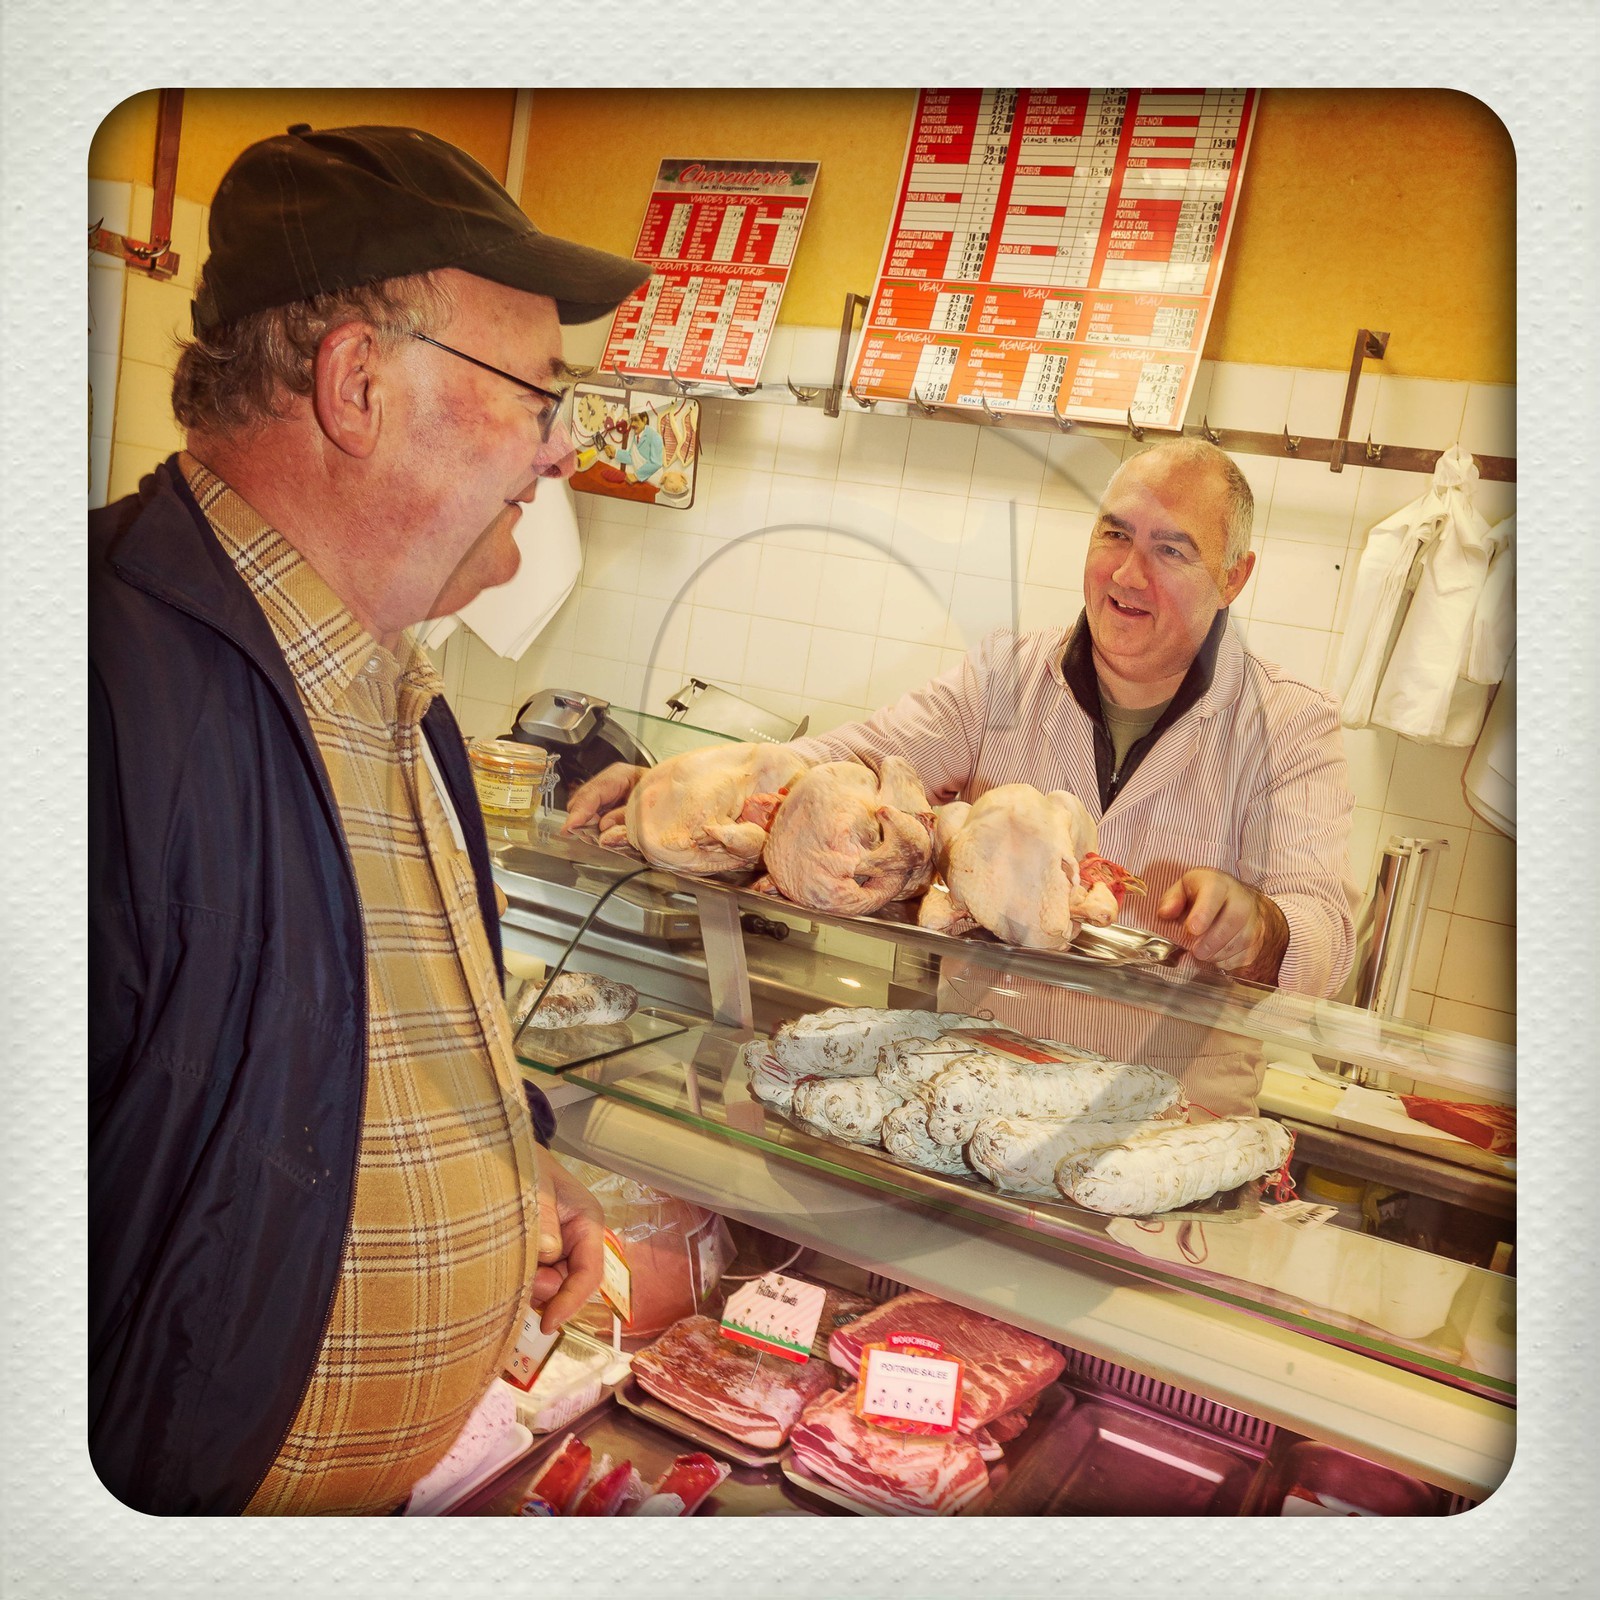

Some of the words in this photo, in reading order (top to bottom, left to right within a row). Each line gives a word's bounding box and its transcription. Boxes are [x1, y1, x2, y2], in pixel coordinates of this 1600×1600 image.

[1130, 138, 1156, 147] PALERON
[914, 154, 936, 163] TRANCHE
[1127, 159, 1148, 168] COLLIER
[679, 163, 790, 186] Charcuterie
[690, 195, 723, 204] VIANDES
[725, 196, 738, 204] DE
[740, 196, 764, 206] PORC
[1117, 200, 1138, 209] JARRET
[1115, 210, 1140, 219] POITRINE
[1113, 220, 1126, 229] PLAT
[1126, 221, 1134, 229] DE
[1110, 230, 1131, 239] DESSUS
[1132, 231, 1140, 239] DE
[1108, 240, 1136, 250] FLANCHET
[1106, 250, 1125, 259] QUEUE
[691, 263, 704, 272] DE
[704, 265, 765, 276] CHARCUTERIE
[918, 282, 944, 292] VEAU
[882, 289, 894, 297] FILET
[1023, 288, 1051, 299] VEAU
[880, 298, 893, 307] NOIX
[1134, 296, 1163, 306] VEAU
[877, 307, 892, 316] QUASI
[982, 306, 999, 314] LONGE
[895, 332, 936, 343] AGNEAU
[868, 340, 884, 349] GIGOT
[999, 340, 1043, 352] AGNEAU
[865, 349, 881, 358] GIGOT
[1109, 349, 1155, 362] AGNEAU
[891, 1335, 942, 1352] BOUCHERIE
